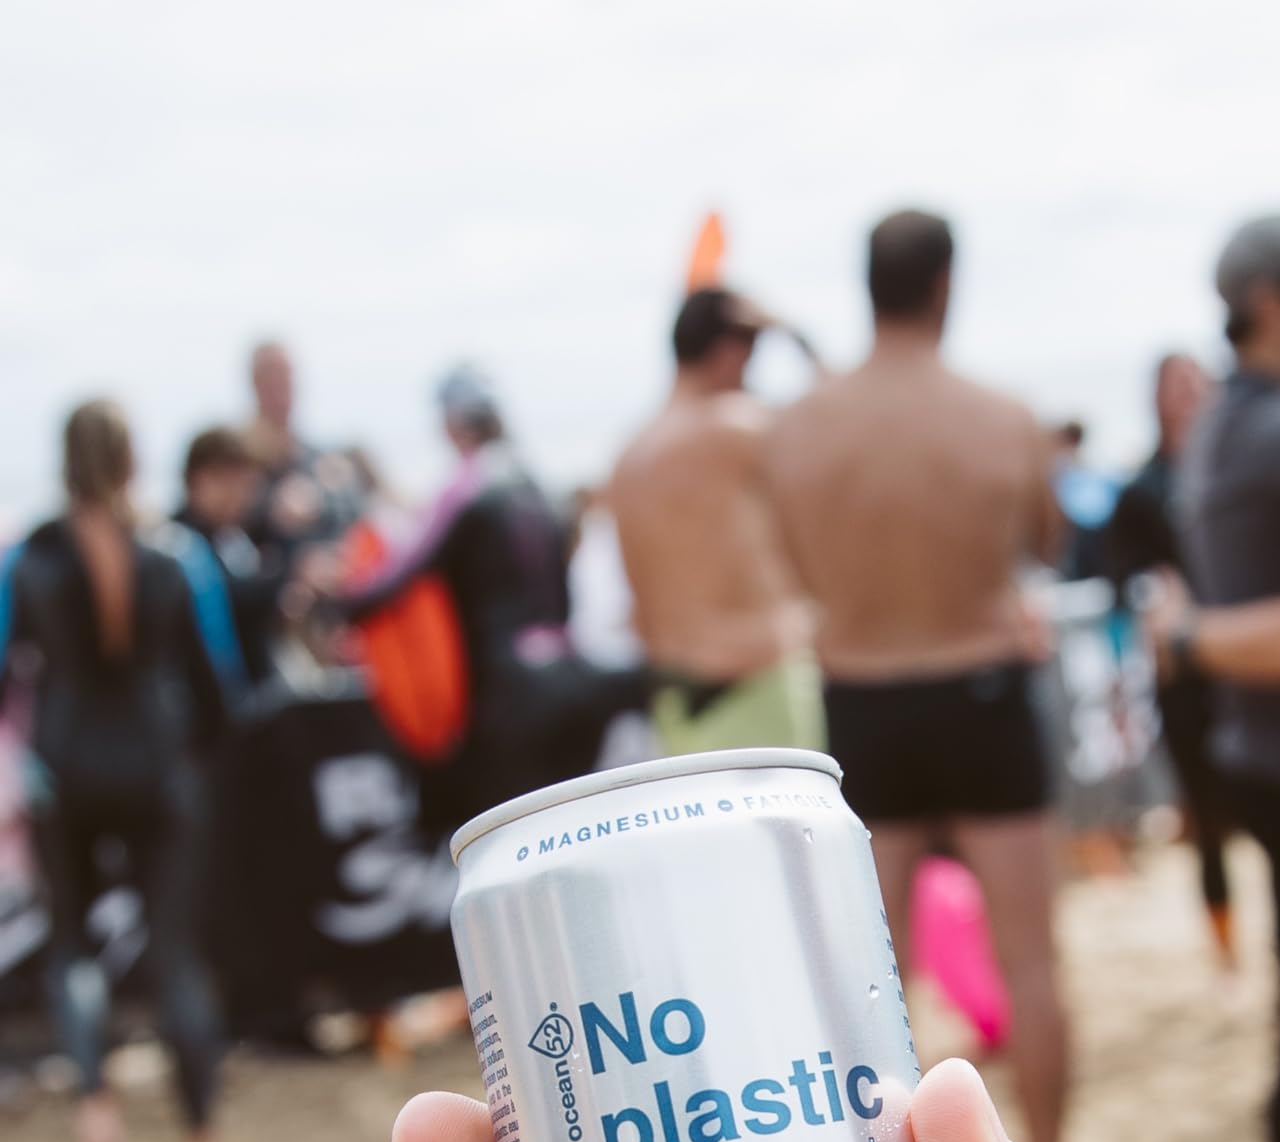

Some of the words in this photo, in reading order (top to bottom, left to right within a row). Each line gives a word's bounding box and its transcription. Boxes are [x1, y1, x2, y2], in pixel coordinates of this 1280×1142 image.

[538, 802, 704, 855] MAGNESIUM
[743, 794, 833, 810] FATIGUE
[578, 991, 706, 1075] No
[555, 1060, 583, 1142] ocean
